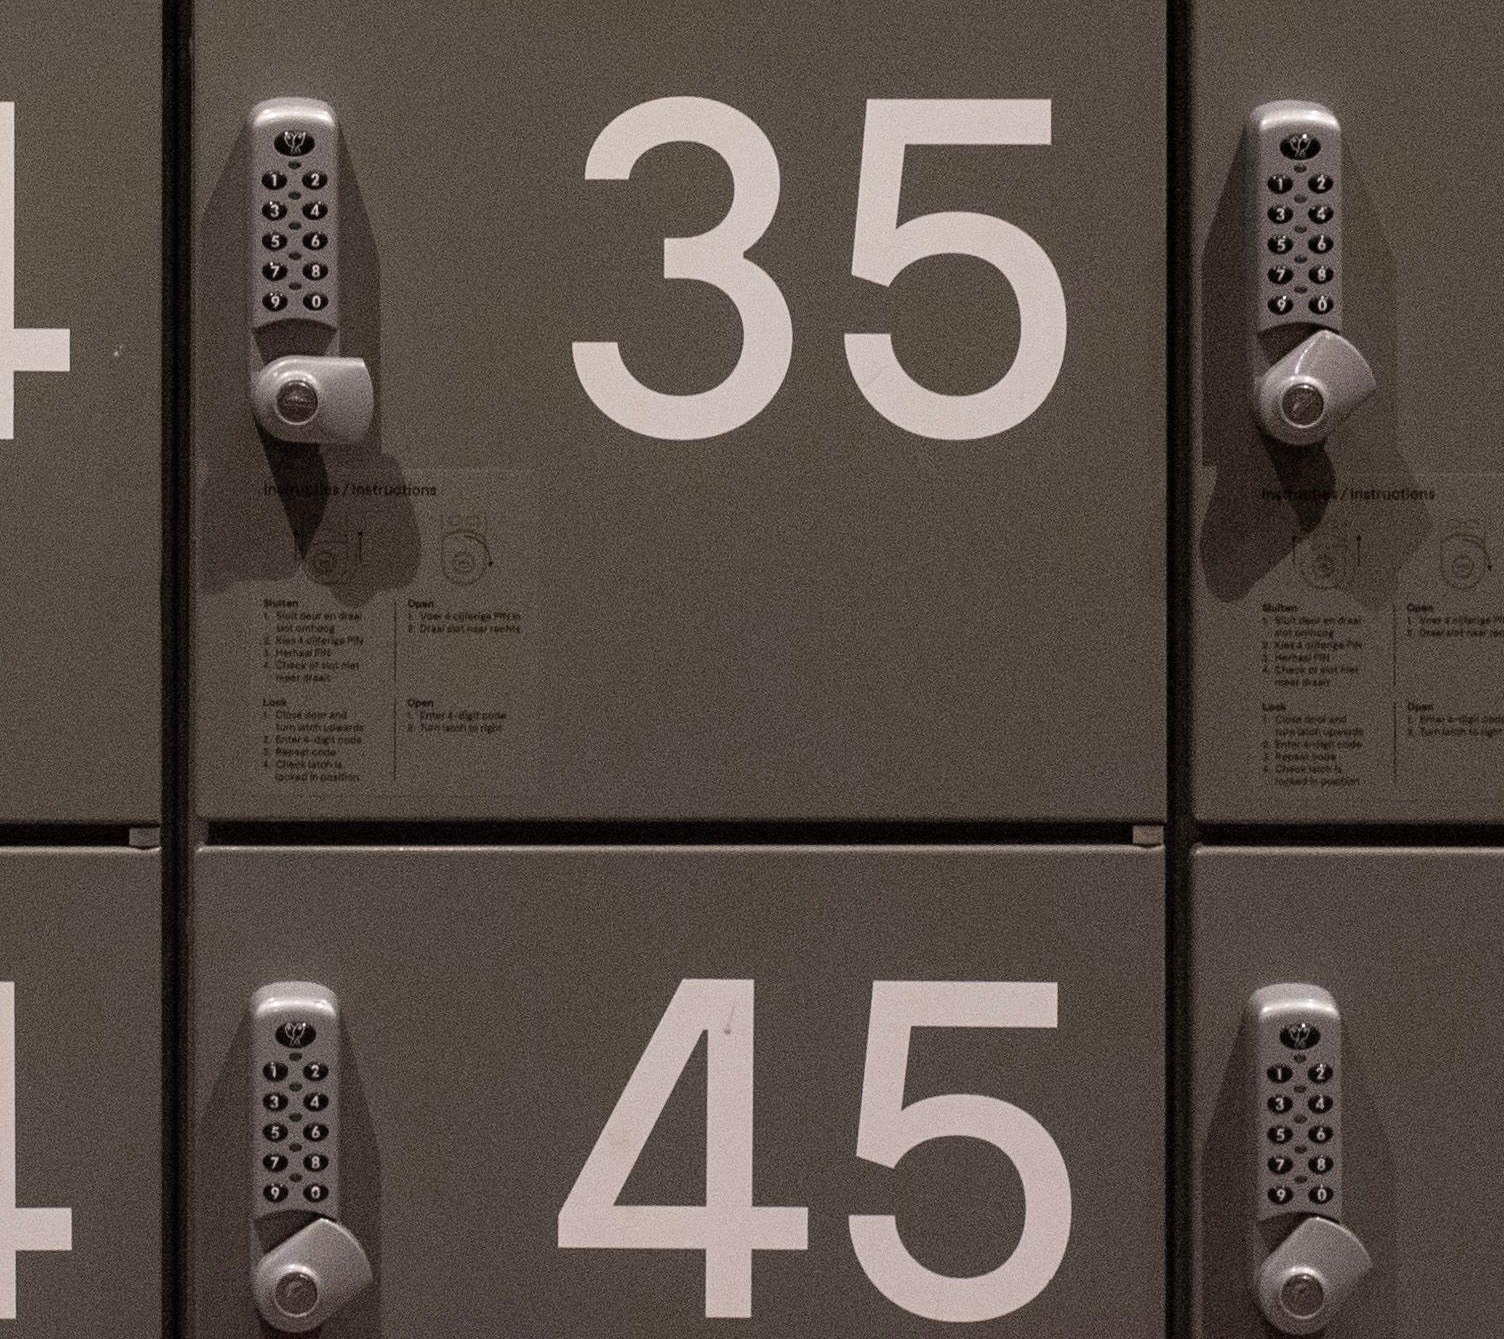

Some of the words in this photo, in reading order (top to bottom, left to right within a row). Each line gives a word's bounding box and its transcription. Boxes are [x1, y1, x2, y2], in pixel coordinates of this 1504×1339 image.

[572, 96, 1067, 441] 35
[1350, 487, 1435, 500] Instructions
[271, 1065, 276, 1078] 1
[311, 1065, 319, 1077] 2
[271, 1096, 278, 1108] 3
[310, 1096, 319, 1108] 4
[272, 1126, 279, 1138] 5
[312, 1126, 320, 1138] 6
[558, 978, 1072, 1322] 45
[271, 1157, 279, 1169] 7
[312, 1156, 320, 1168] 8
[271, 1187, 280, 1199] 9
[311, 1186, 320, 1198] 0
